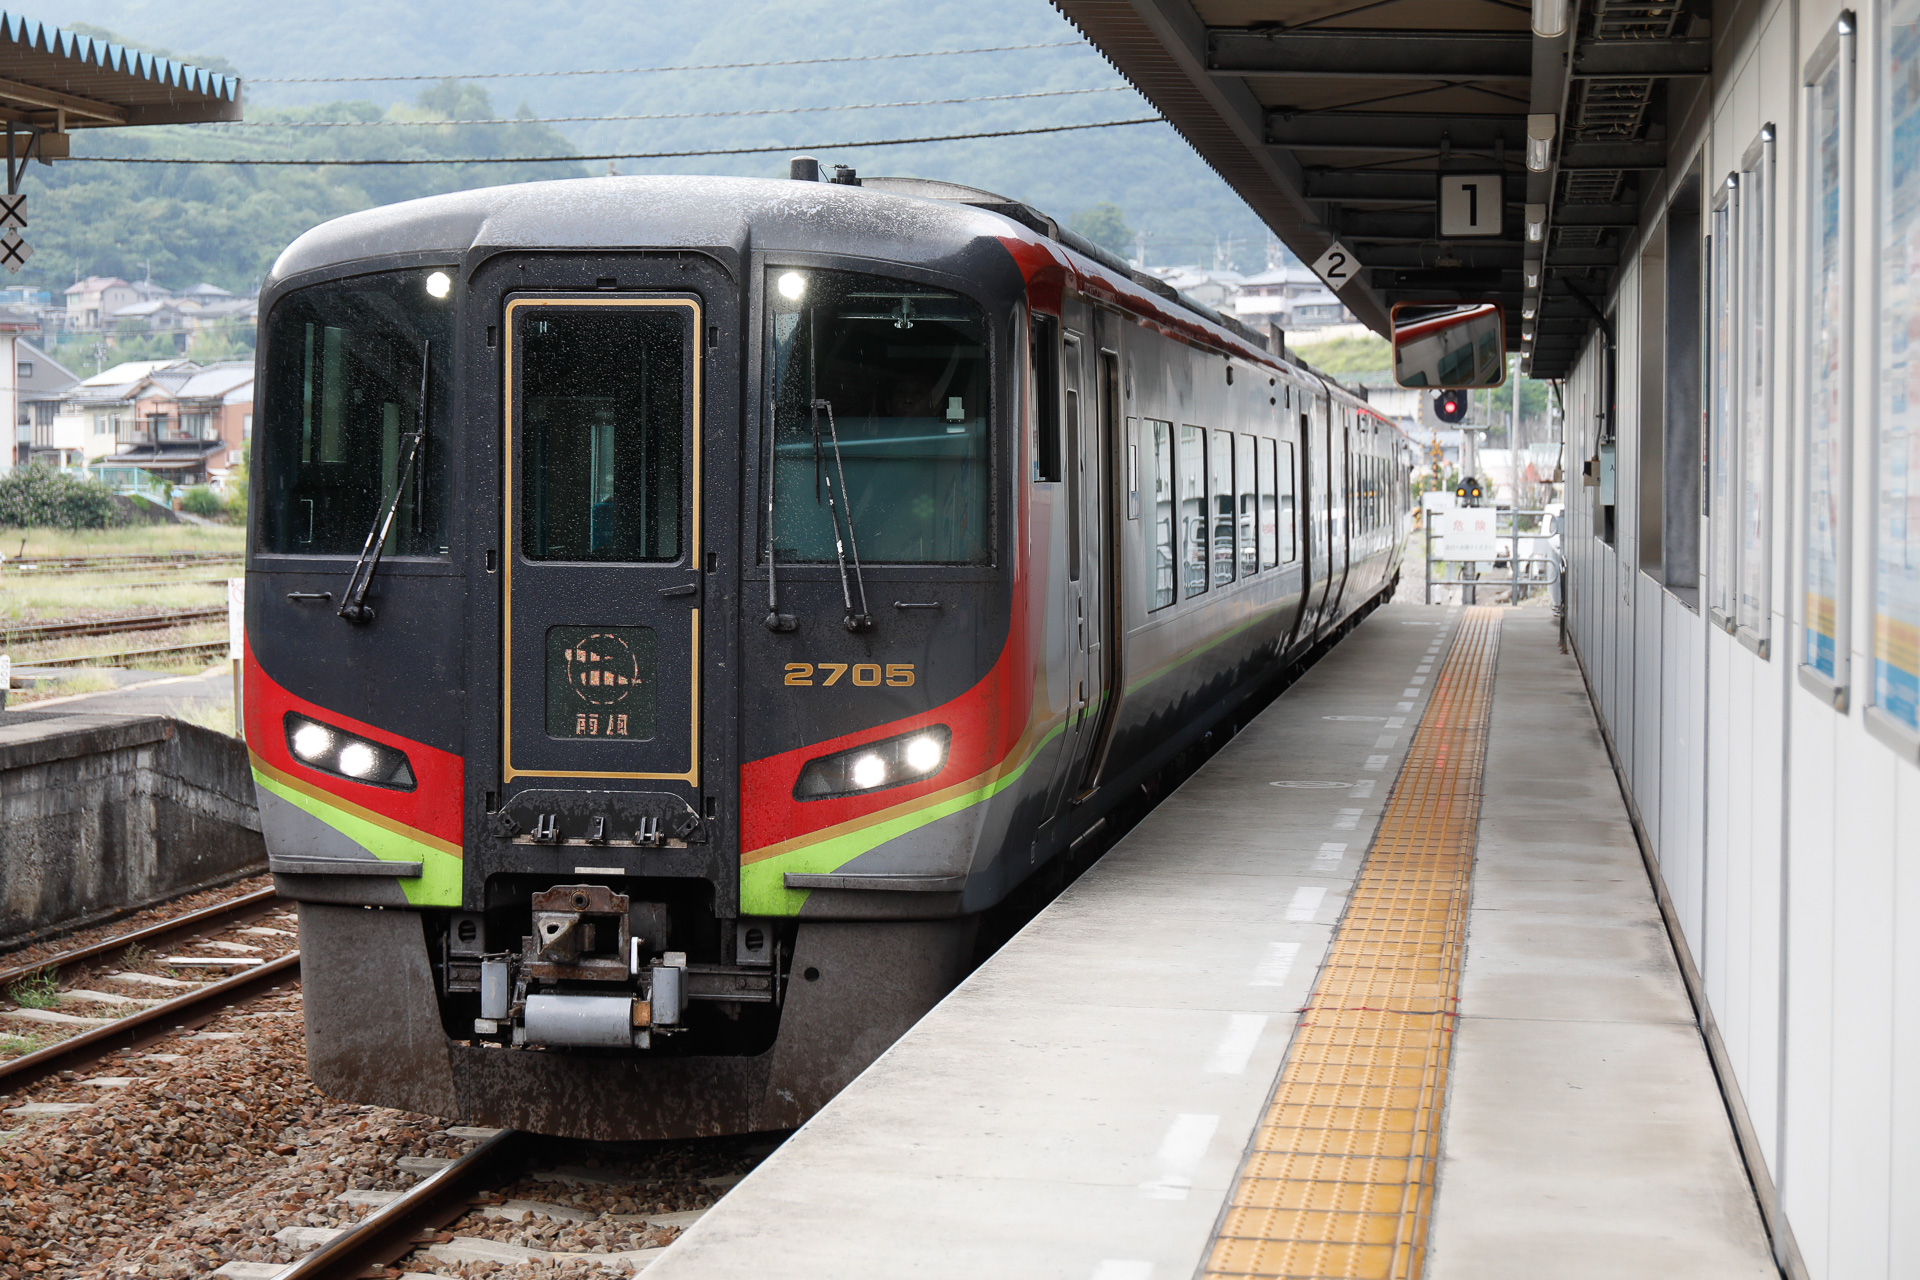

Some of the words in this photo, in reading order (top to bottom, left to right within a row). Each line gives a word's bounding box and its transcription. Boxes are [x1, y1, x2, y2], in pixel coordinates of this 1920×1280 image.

[1462, 184, 1477, 226] 1
[1327, 252, 1346, 278] 2
[784, 662, 915, 687] 2705
